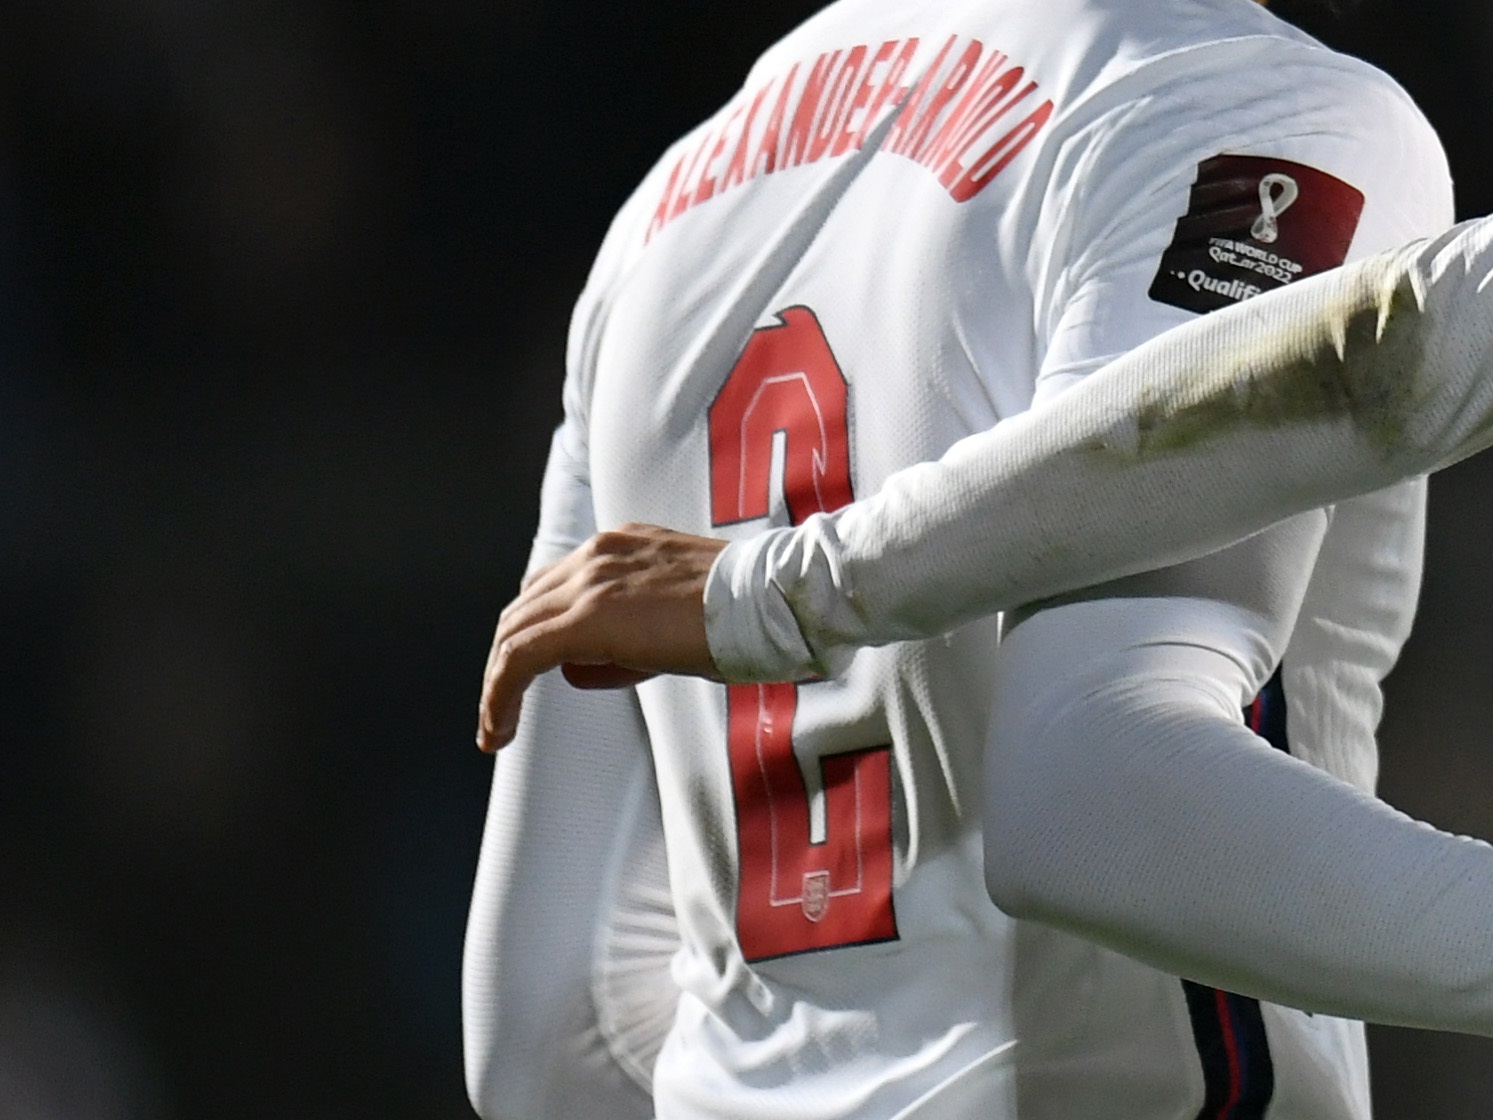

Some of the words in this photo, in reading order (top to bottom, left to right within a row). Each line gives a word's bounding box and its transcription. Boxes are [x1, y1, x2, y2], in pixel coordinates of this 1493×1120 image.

[1235, 241, 1278, 264] WORLD
[1279, 258, 1303, 274] CUP
[709, 304, 900, 963] 2
